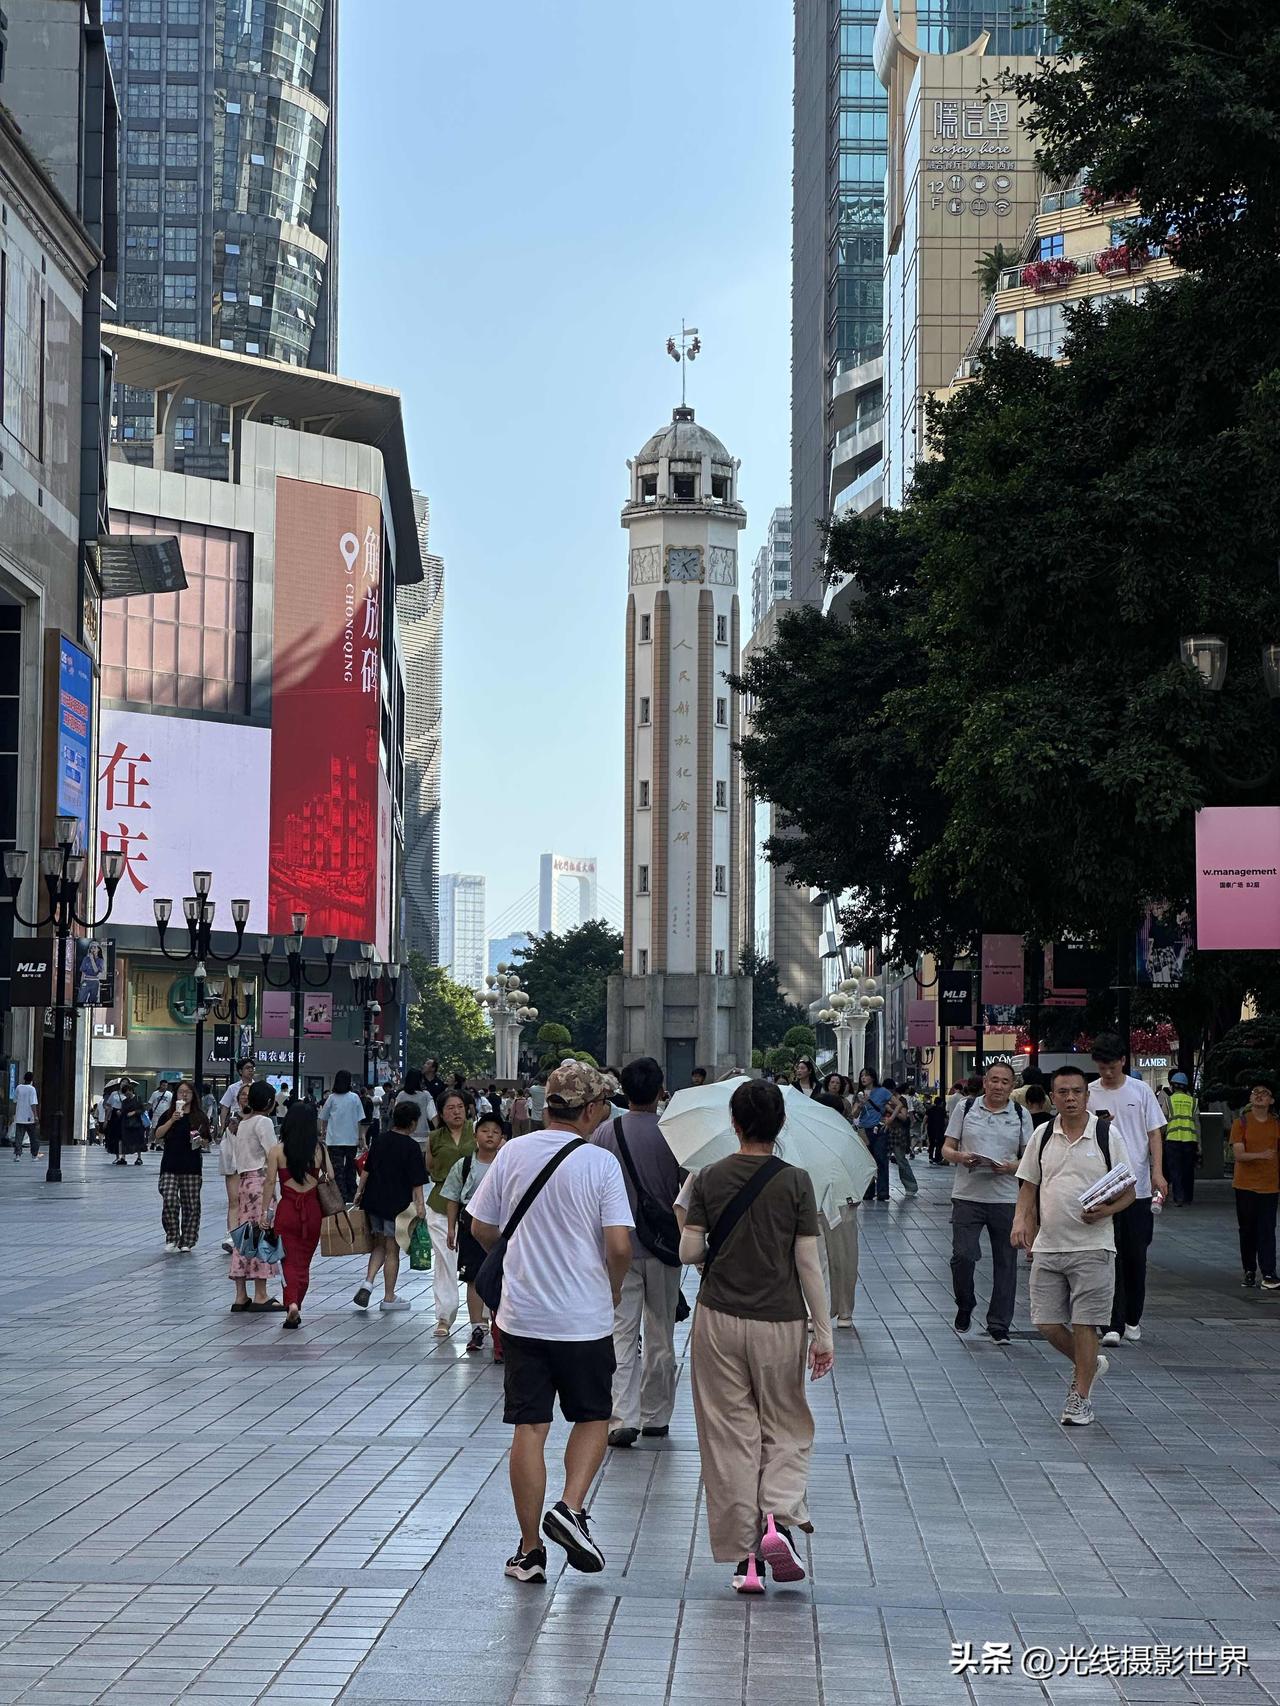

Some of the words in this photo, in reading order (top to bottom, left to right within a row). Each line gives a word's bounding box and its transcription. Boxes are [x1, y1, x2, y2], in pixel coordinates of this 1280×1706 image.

[930, 141, 975, 159] enjoy
[979, 140, 1012, 154] here
[928, 181, 944, 193] 12
[343, 583, 354, 682] CHONGQING
[1203, 868, 1277, 876] w.management
[16, 962, 47, 972] MLB
[942, 990, 967, 998] MLB
[254, 1050, 306, 1063] 国农业银行
